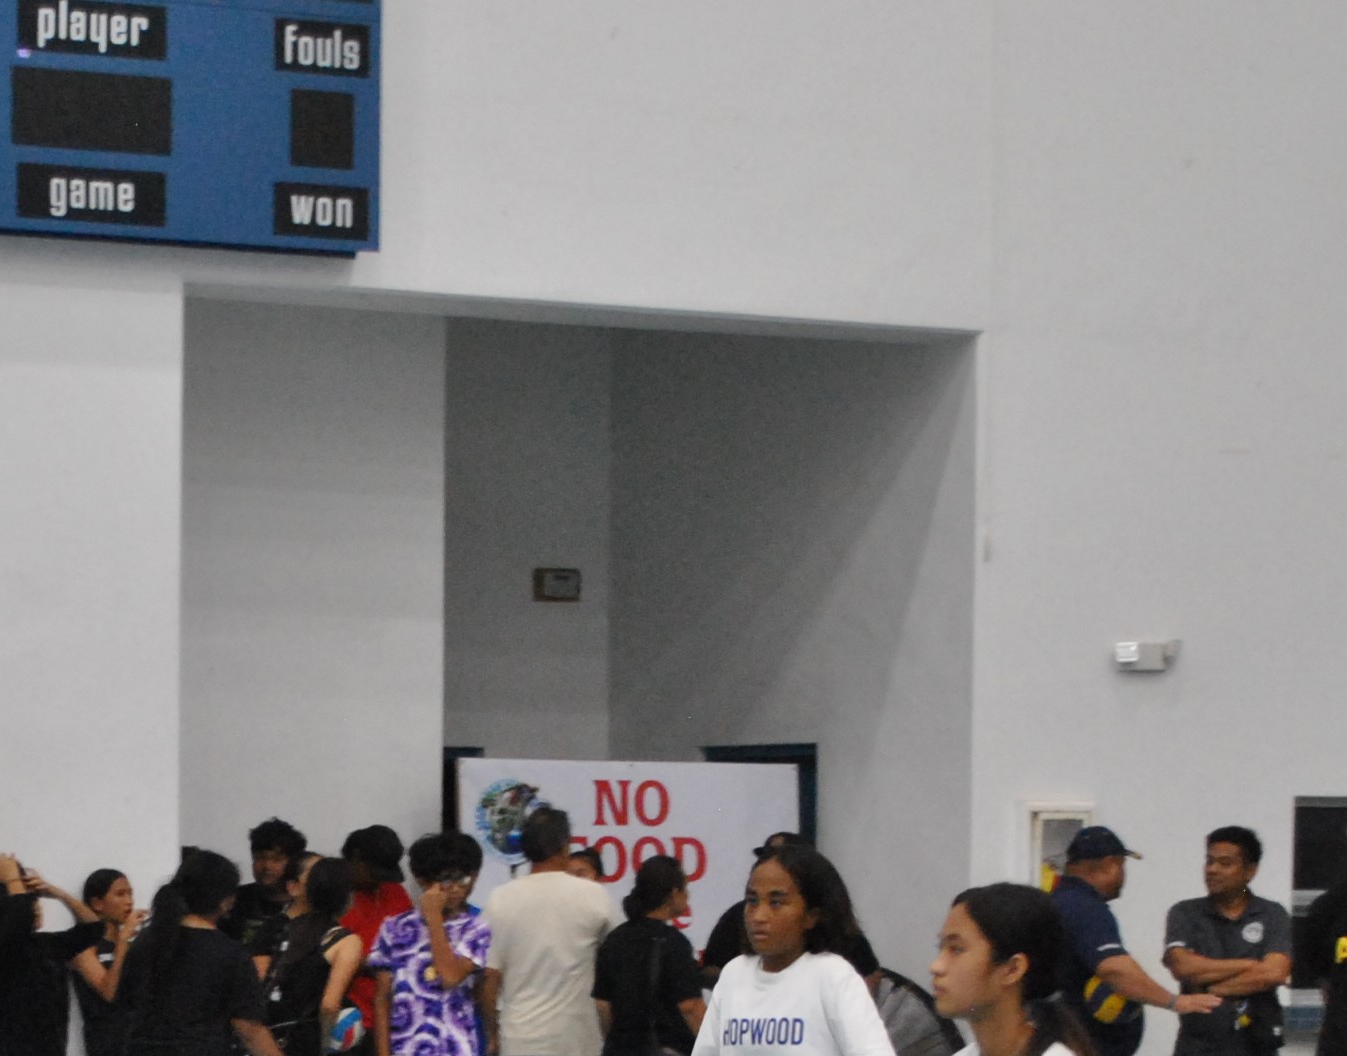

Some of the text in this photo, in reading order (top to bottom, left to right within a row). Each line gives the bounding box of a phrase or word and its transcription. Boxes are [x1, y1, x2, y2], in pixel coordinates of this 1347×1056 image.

[37, 0, 150, 53] player
[284, 24, 360, 70] fouls
[49, 177, 135, 217] game
[290, 195, 354, 229] won
[593, 780, 670, 826] NO
[722, 1017, 804, 1046] HOPWOOD
